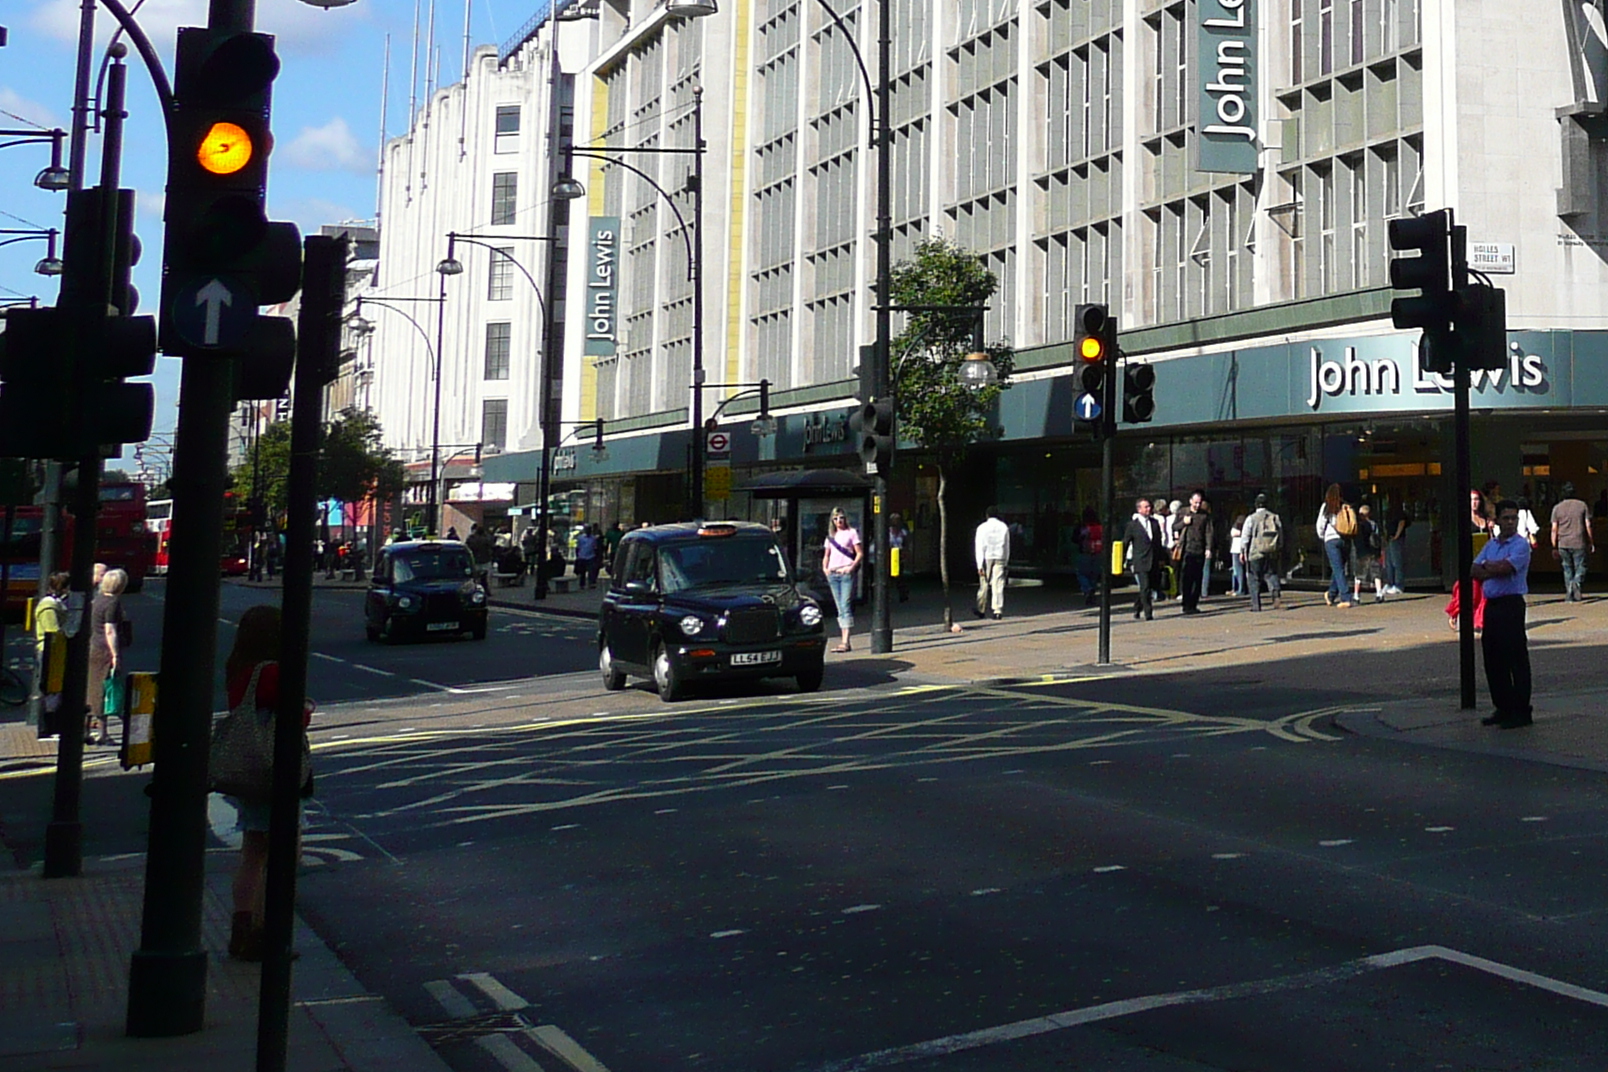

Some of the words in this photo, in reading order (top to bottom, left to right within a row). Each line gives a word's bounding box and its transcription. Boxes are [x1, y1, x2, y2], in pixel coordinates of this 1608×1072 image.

[1201, 39, 1256, 142] John
[588, 229, 613, 288] Lewis
[1474, 254, 1499, 263] STREET
[586, 291, 615, 342] John
[1306, 344, 1399, 410] John
